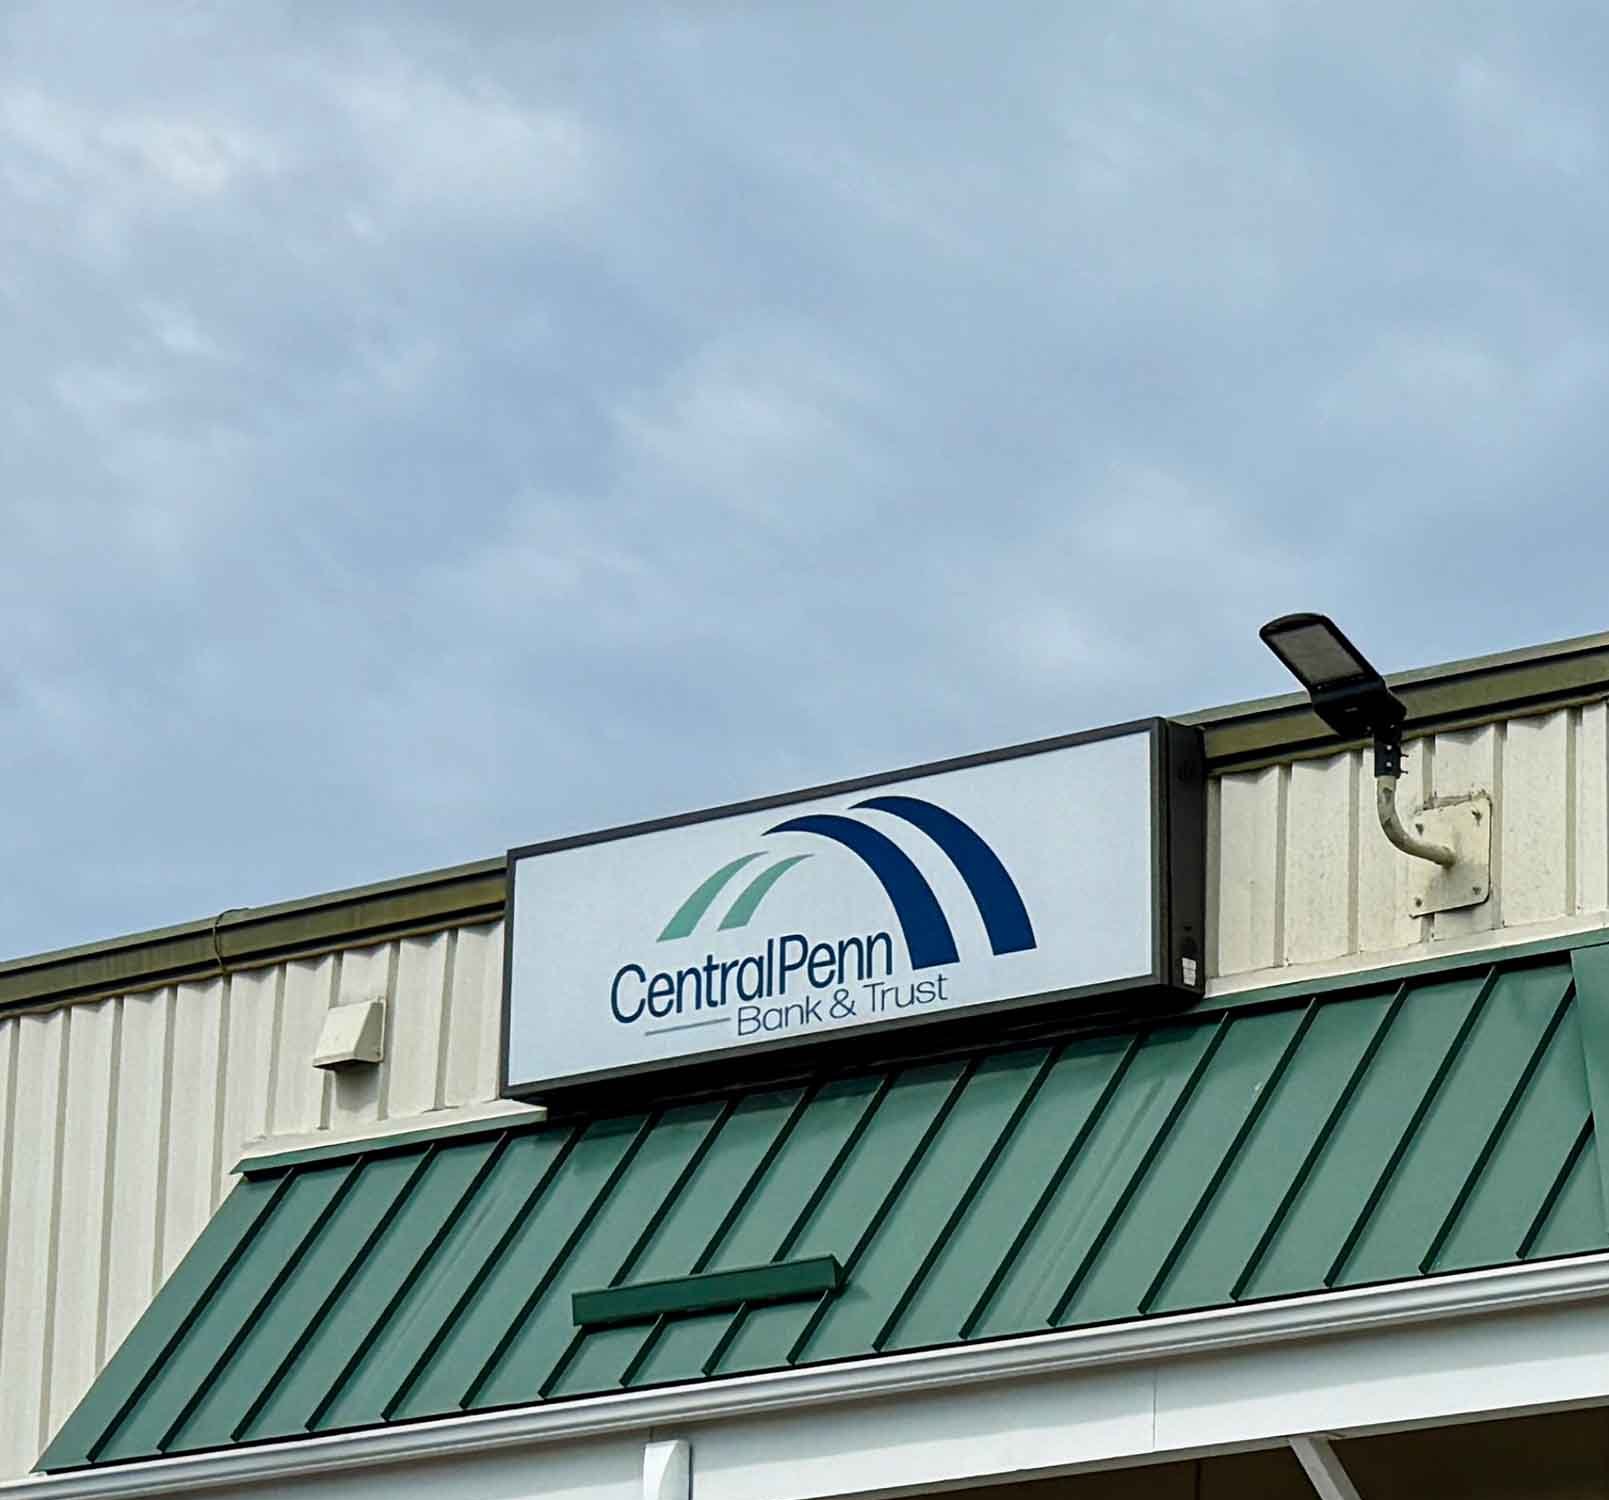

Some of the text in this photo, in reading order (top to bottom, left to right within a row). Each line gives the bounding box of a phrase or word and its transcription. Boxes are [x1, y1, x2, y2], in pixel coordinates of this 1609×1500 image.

[610, 931, 892, 1024] CentralPenn
[737, 973, 949, 1036] Bank & Trust
